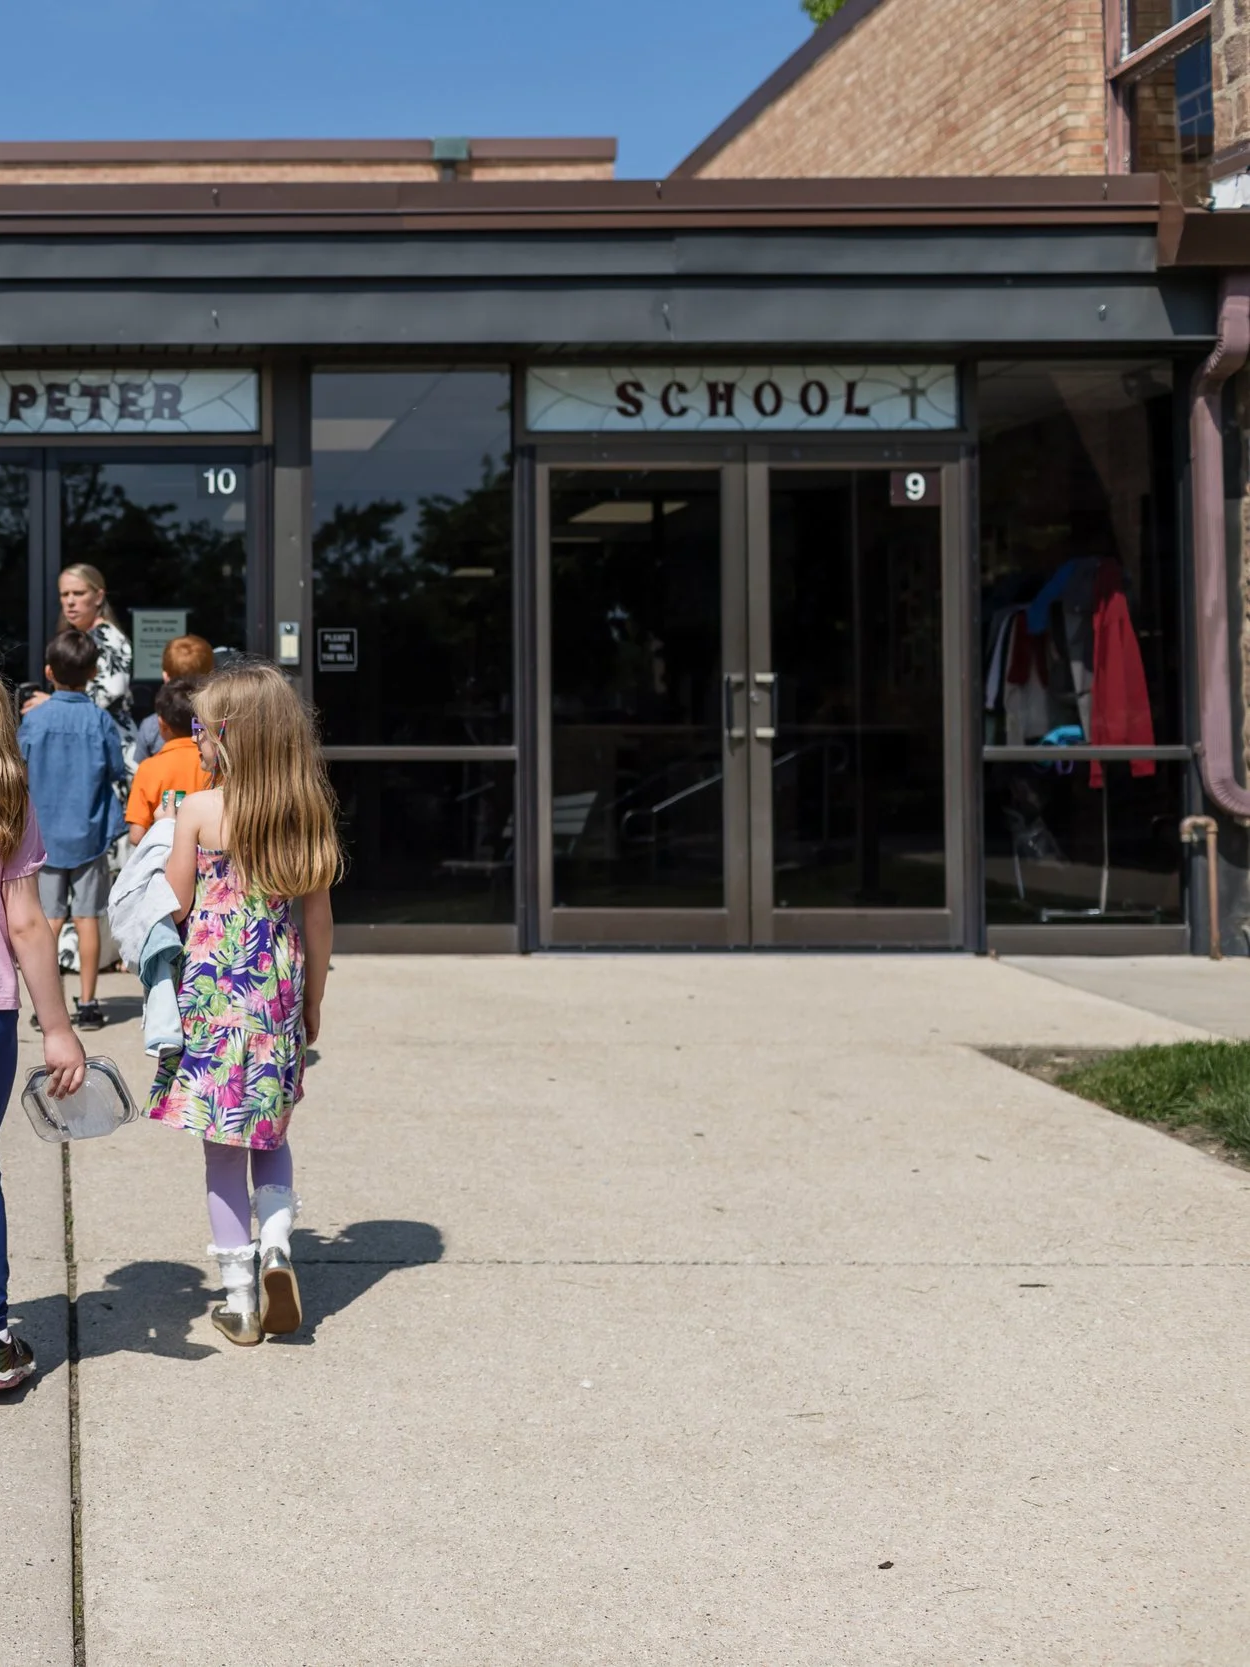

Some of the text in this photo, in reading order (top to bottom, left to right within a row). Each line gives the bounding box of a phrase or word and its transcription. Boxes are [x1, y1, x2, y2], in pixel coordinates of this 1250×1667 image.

[8, 382, 184, 421] PETER
[615, 380, 870, 417] SCHOOL
[202, 468, 237, 495] 10
[905, 472, 926, 501] 9
[323, 633, 351, 642] PLEASE
